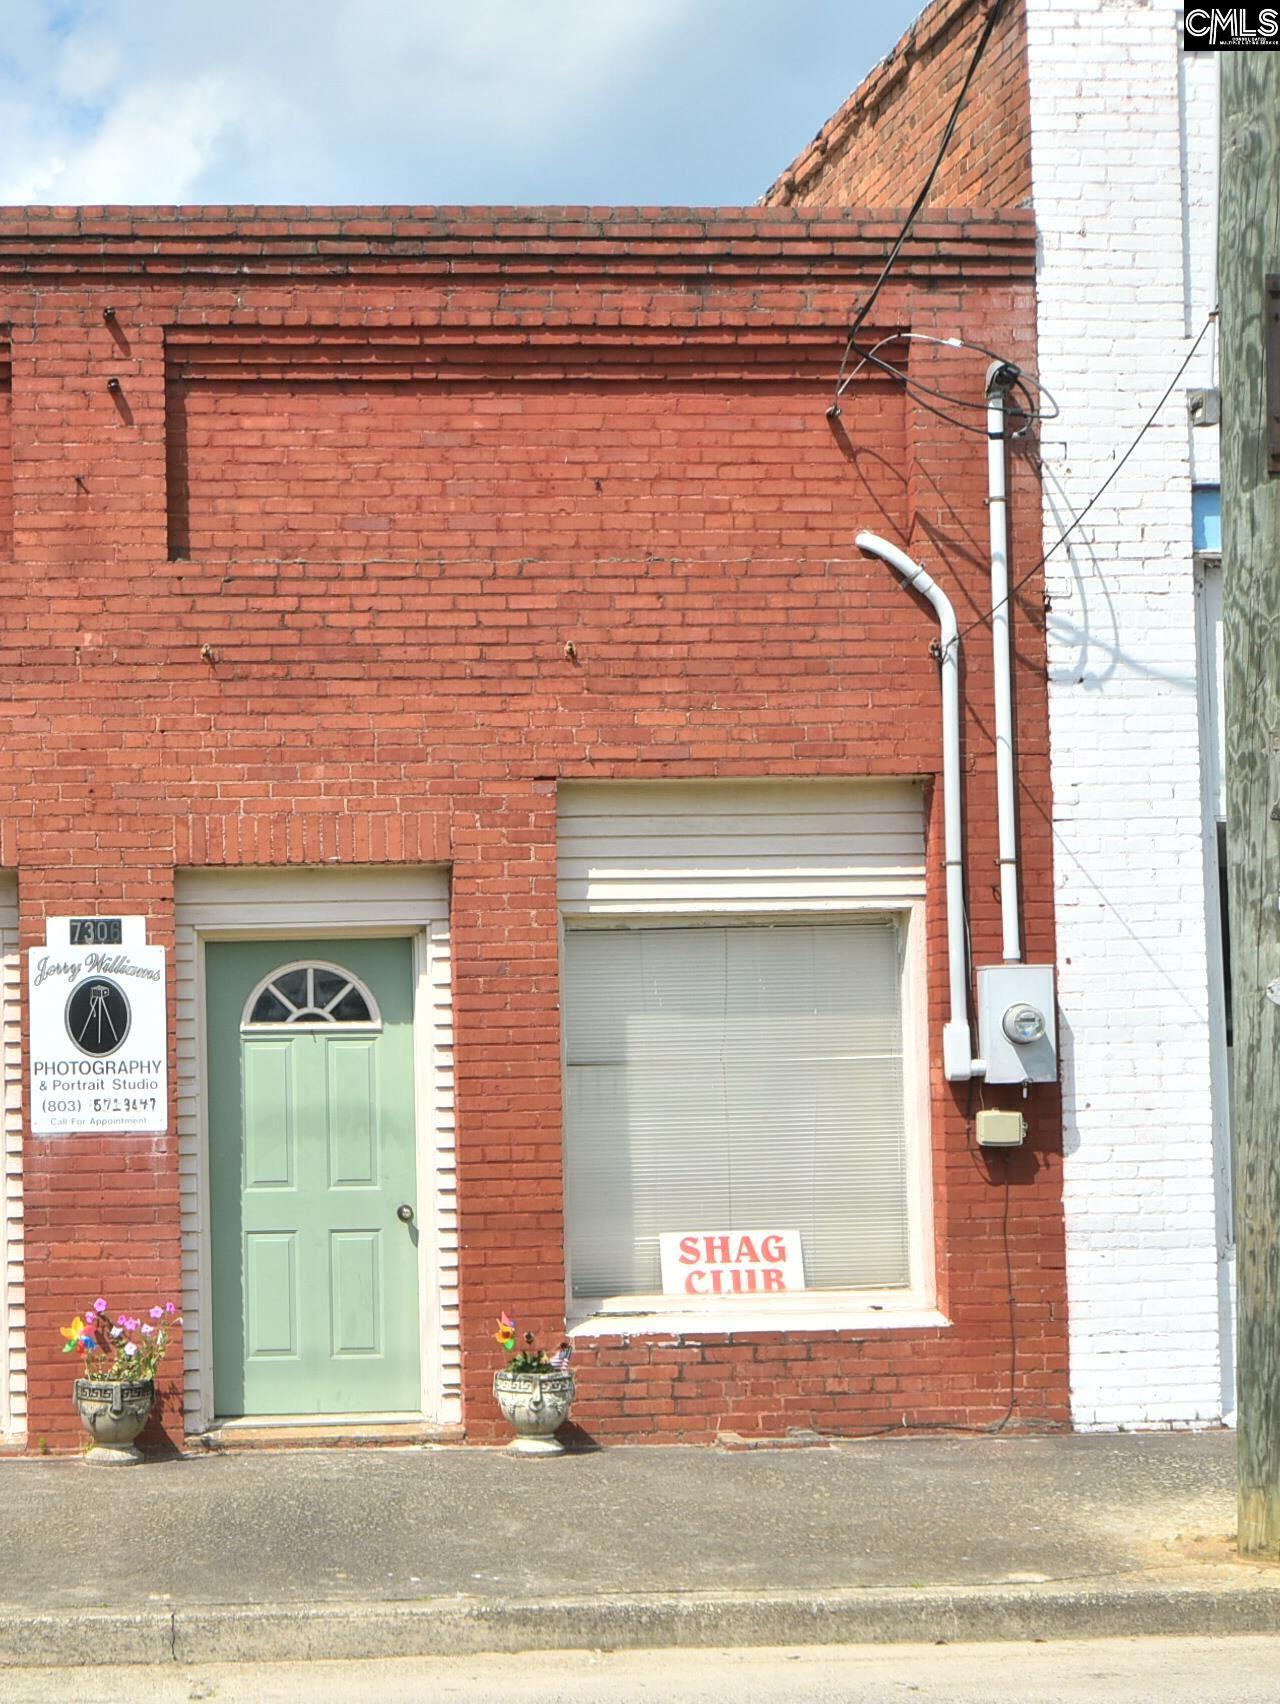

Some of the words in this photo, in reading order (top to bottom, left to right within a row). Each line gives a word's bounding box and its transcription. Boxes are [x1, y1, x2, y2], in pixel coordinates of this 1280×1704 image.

[70, 921, 120, 944] 7306
[85, 952, 161, 981] Williams
[34, 1060, 161, 1075] PHOTOGRAPHY
[39, 1080, 47, 1091] &
[52, 1079, 104, 1091] Portrait
[112, 1078, 158, 1090] Studio
[42, 1099, 81, 1112] (803)
[50, 1117, 68, 1126] Call
[71, 1117, 86, 1126] For
[90, 1117, 147, 1126] Appointment
[678, 1235, 786, 1265] SHAG
[685, 1268, 786, 1295] CLUB
